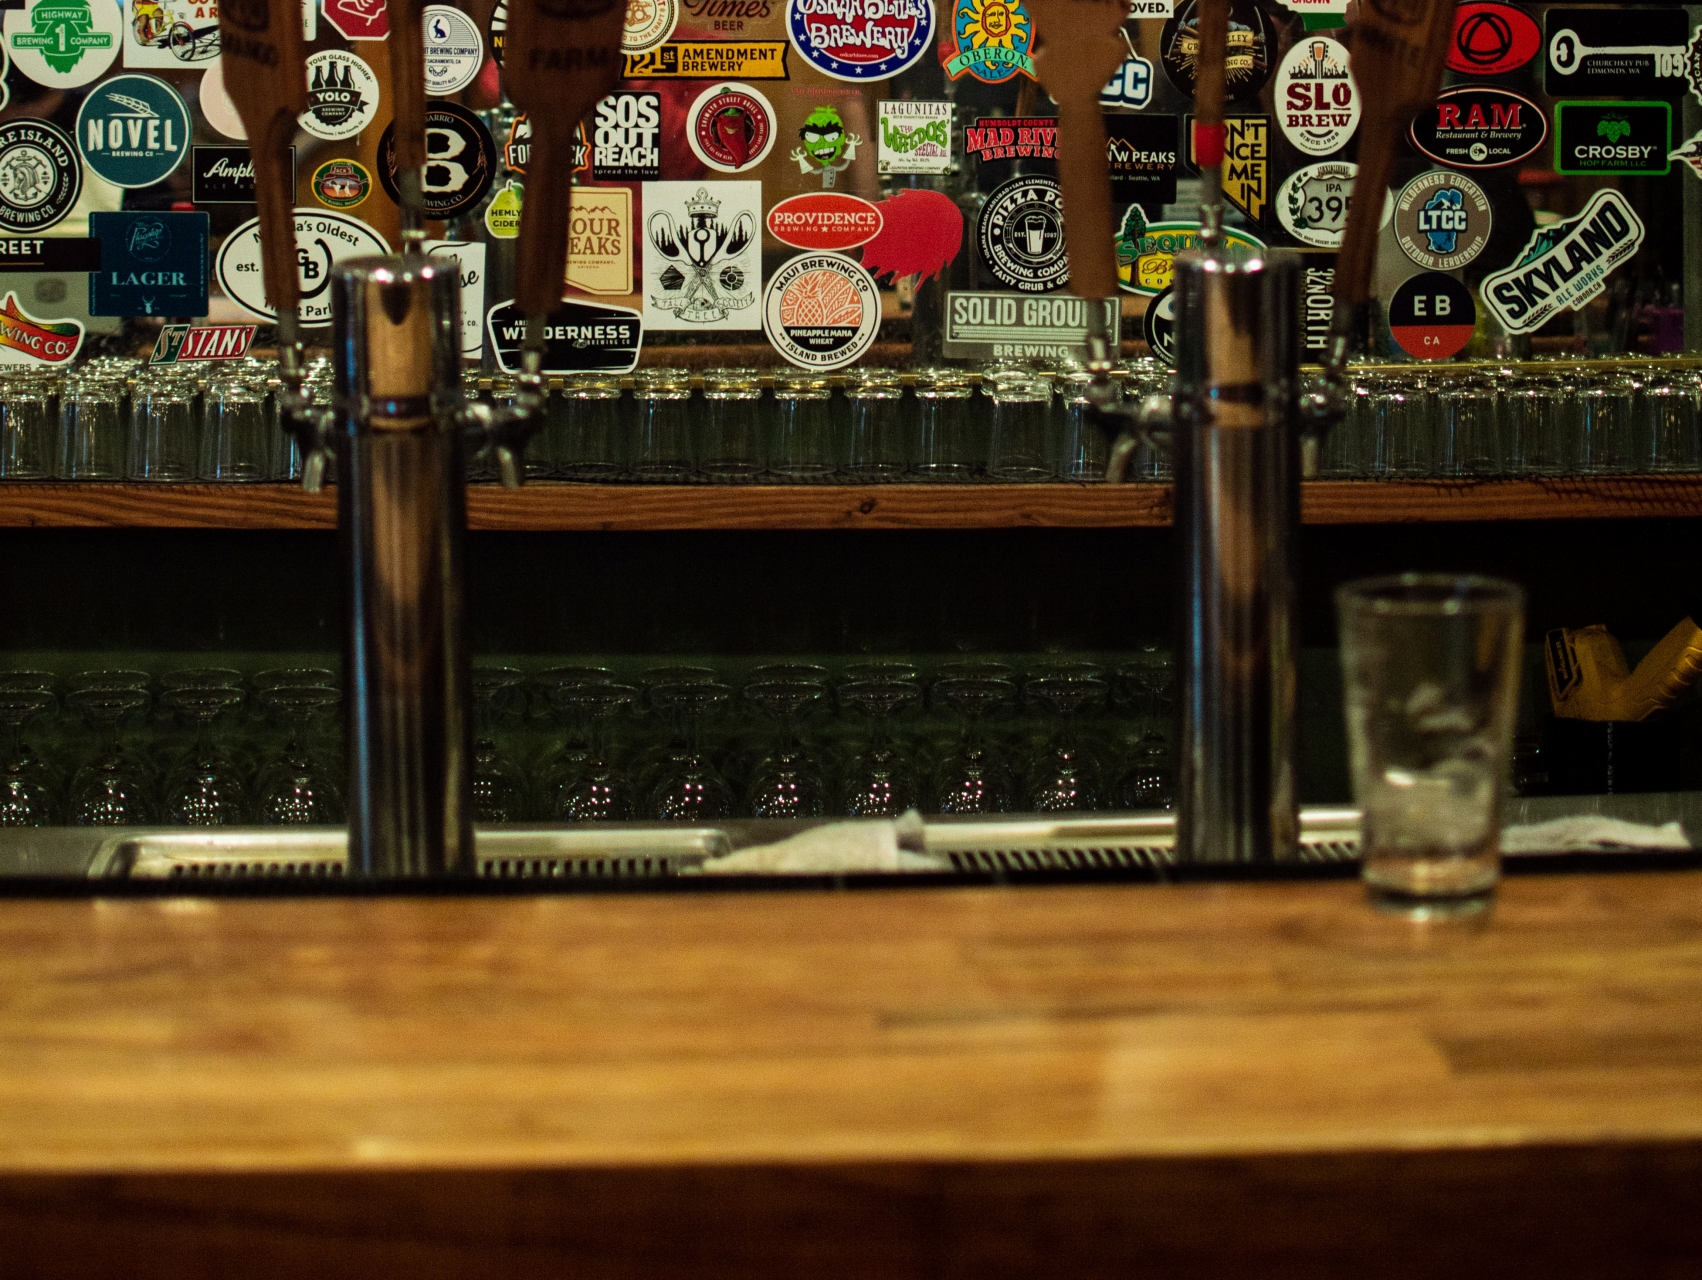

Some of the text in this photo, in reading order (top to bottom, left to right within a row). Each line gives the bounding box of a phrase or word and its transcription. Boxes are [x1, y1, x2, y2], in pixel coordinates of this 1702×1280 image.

[41, 10, 88, 19] HIGHWAY
[809, 24, 912, 58] BREWERY
[682, 61, 743, 72] BREWERY
[959, 48, 1027, 67] OBERON
[316, 92, 350, 103] YOLO
[1286, 82, 1352, 112] SLO
[594, 95, 658, 128] SOS
[882, 103, 948, 115] LAGUNITAS
[1436, 103, 1522, 130] RAM
[87, 119, 177, 153] NOVEL
[594, 128, 658, 148] OUT
[966, 129, 1014, 154] MAD
[1435, 130, 1522, 140] Restaurant & Brewery
[594, 148, 658, 167] REACH
[1132, 151, 1175, 163] PEAKS
[491, 209, 522, 217] HEMLY
[774, 213, 875, 225] PROVIDENCE
[1419, 210, 1466, 230] LTCC
[493, 219, 520, 228] CIDER
[316, 221, 360, 247] Oldest
[1401, 235, 1484, 267] OUTDOOR LEADERSHIP
[1495, 201, 1632, 320] SKYLAND
[236, 262, 259, 273] est.
[775, 259, 857, 292] MAUI BREWING
[111, 271, 186, 286] LAGER
[954, 298, 1016, 325] SOLID
[785, 338, 859, 361] ISLAND BREWED
[993, 344, 1069, 358] BREWING
